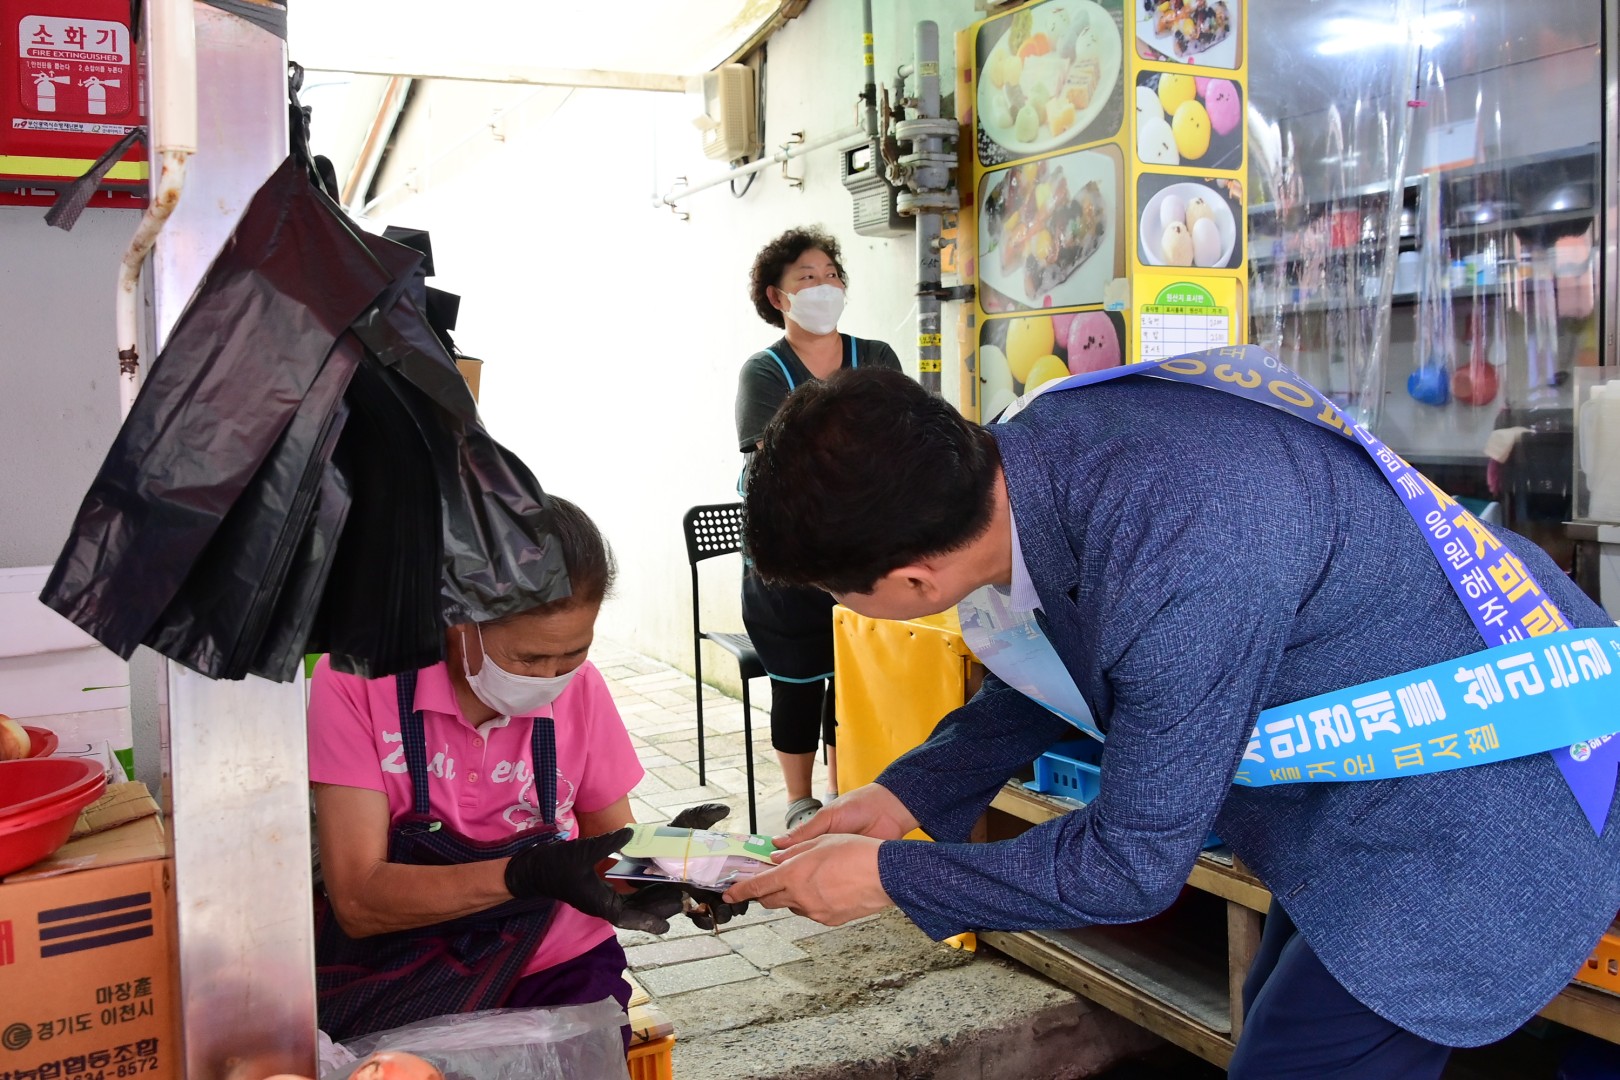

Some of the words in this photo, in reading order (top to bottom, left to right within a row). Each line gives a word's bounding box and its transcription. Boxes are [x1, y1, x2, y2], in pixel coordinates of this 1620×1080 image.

[31, 24, 117, 52] 소화기
[32, 49, 51, 57] FIRE
[53, 50, 118, 62] EXTINGUISHER
[1166, 293, 1184, 303] 원산지
[1269, 753, 1376, 781] 즐거운
[1391, 722, 1500, 772] 피서철
[37, 1013, 93, 1041] 경기도
[101, 998, 154, 1026] 이천시
